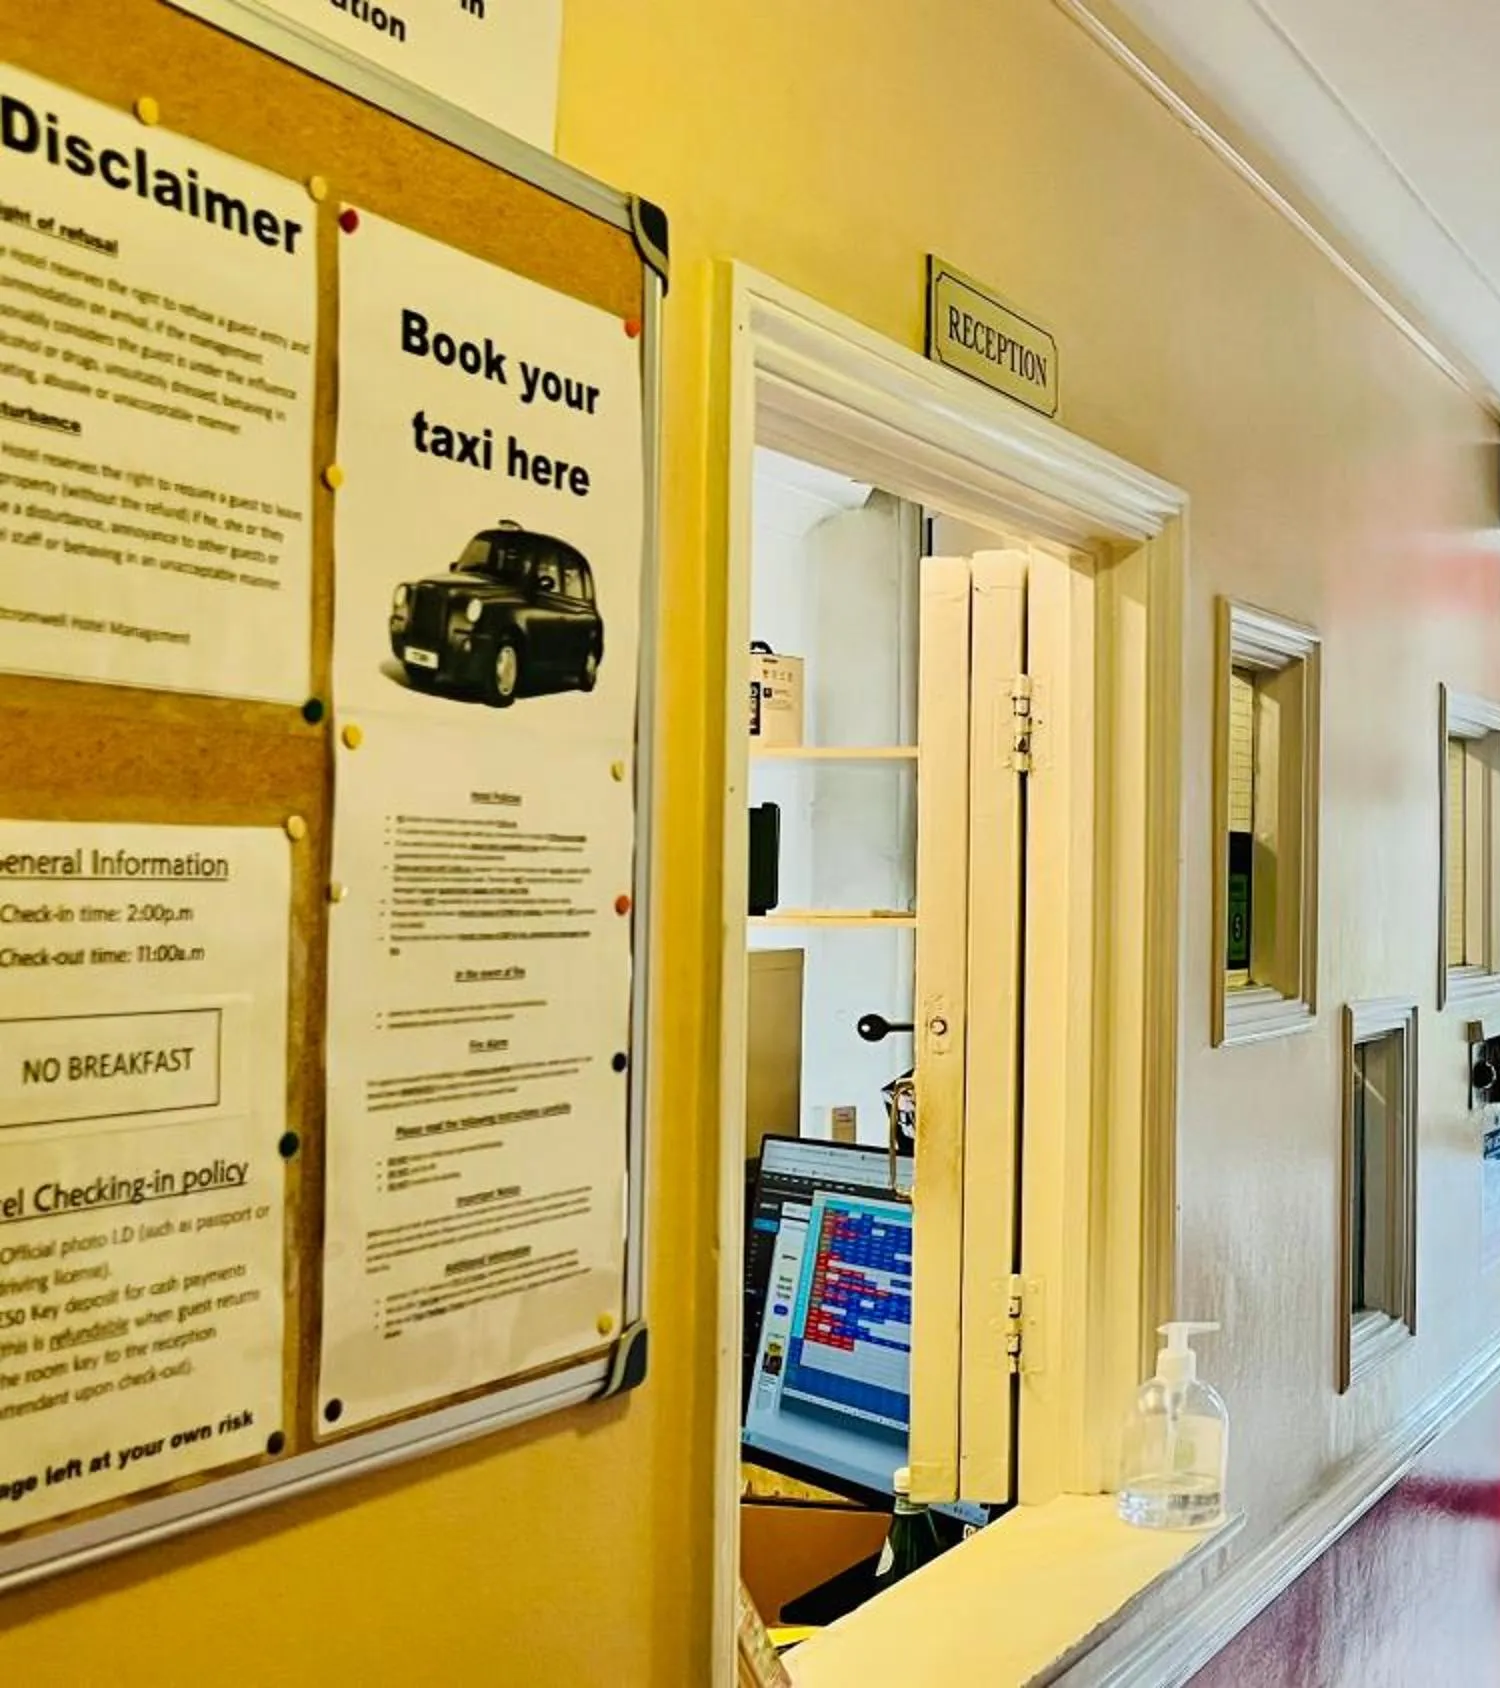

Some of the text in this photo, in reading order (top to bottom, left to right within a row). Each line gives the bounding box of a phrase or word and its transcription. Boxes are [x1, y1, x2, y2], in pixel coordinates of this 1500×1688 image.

[0, 95, 303, 254] Disclaimer
[402, 308, 600, 415] Book your
[948, 305, 1047, 388] RECEPTION
[412, 410, 590, 497] taxi here
[93, 851, 229, 879] Information
[0, 904, 195, 926] Check-in time: 2:00p.m
[0, 949, 84, 968] Check-out
[90, 949, 131, 965] time:
[22, 1048, 195, 1084] NO BREAKFAST
[33, 1169, 174, 1213] Checking-in
[181, 1159, 249, 1195] policy
[45, 1458, 84, 1487] left
[88, 1453, 111, 1474] at
[118, 1438, 165, 1469] your
[170, 1424, 213, 1449] own
[217, 1409, 254, 1435] risk
